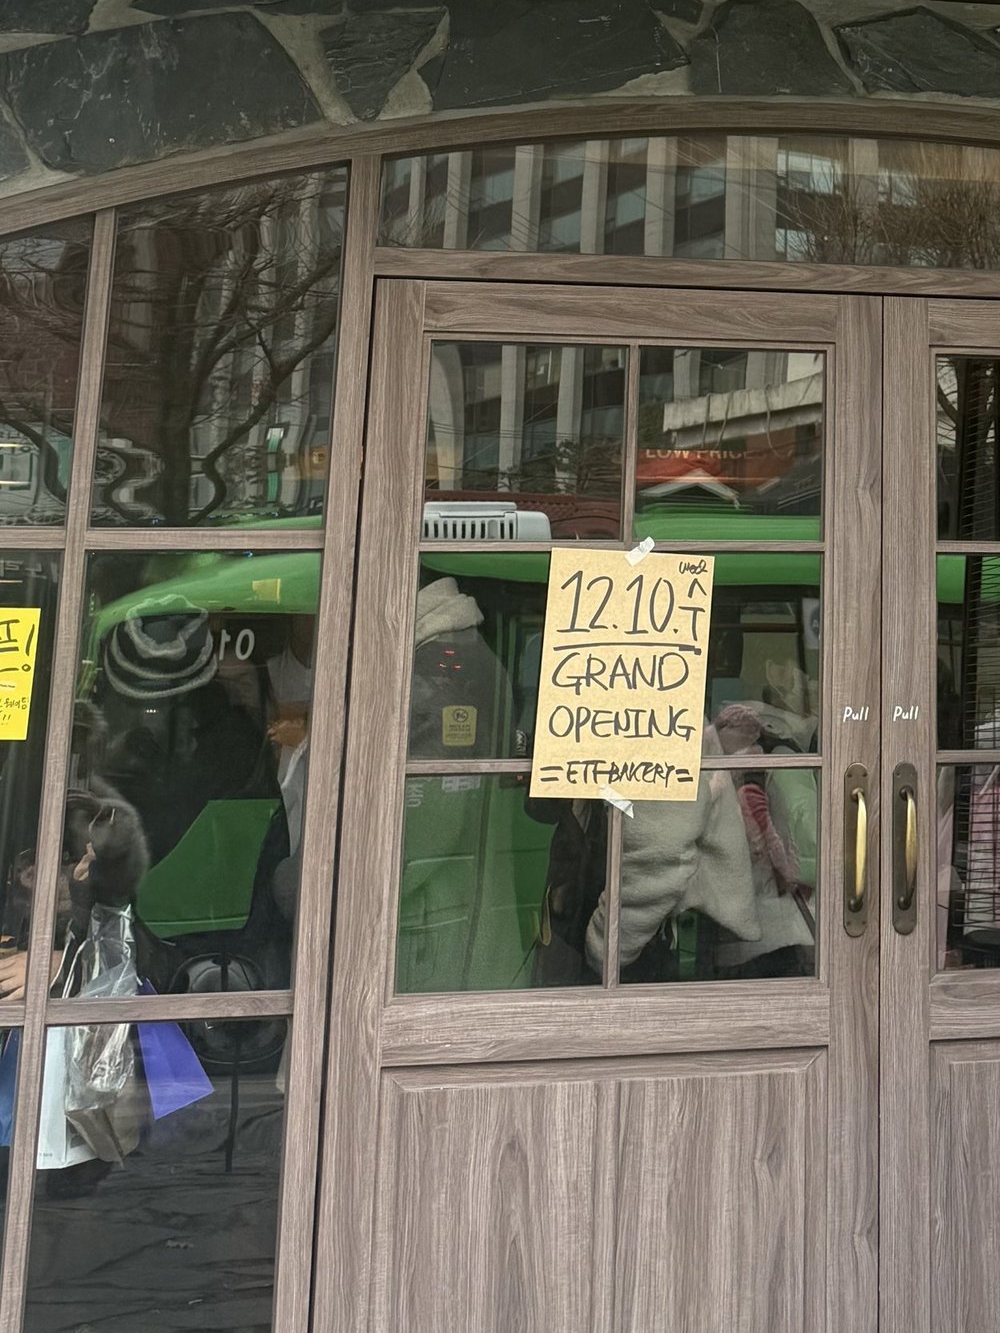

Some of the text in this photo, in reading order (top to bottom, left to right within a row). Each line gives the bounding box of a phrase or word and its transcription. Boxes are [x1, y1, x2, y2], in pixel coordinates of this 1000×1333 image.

[551, 652, 689, 695] GRAND
[549, 705, 696, 742] OPENING
[842, 706, 869, 723] Pull
[892, 705, 919, 722] Pull
